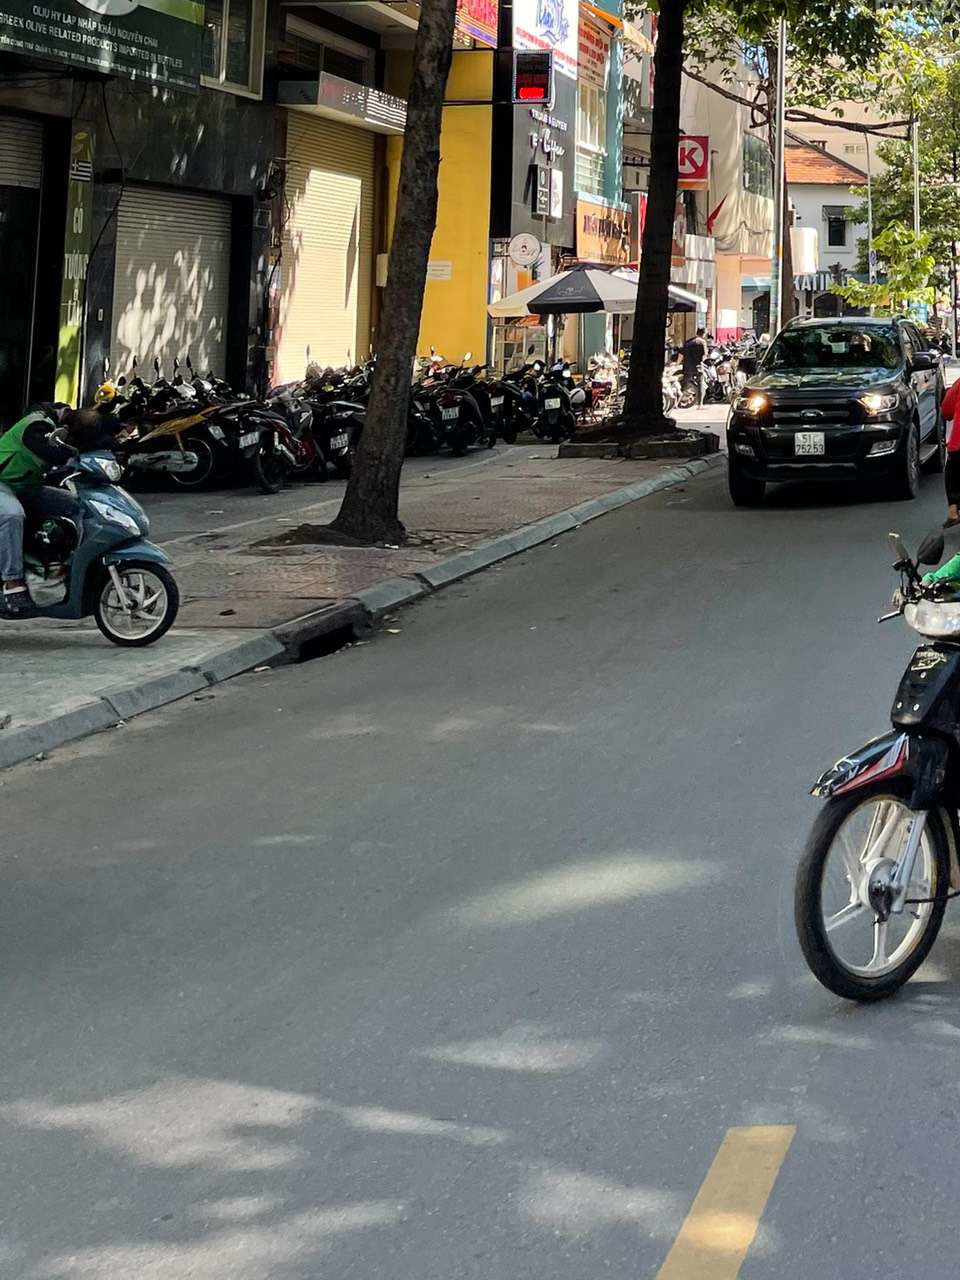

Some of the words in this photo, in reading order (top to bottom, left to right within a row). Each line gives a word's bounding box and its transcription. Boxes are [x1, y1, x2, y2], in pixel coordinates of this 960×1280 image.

[25, 19, 48, 34] OLIVE
[49, 25, 81, 42] RELATED
[82, 34, 118, 52] PRODUCTS
